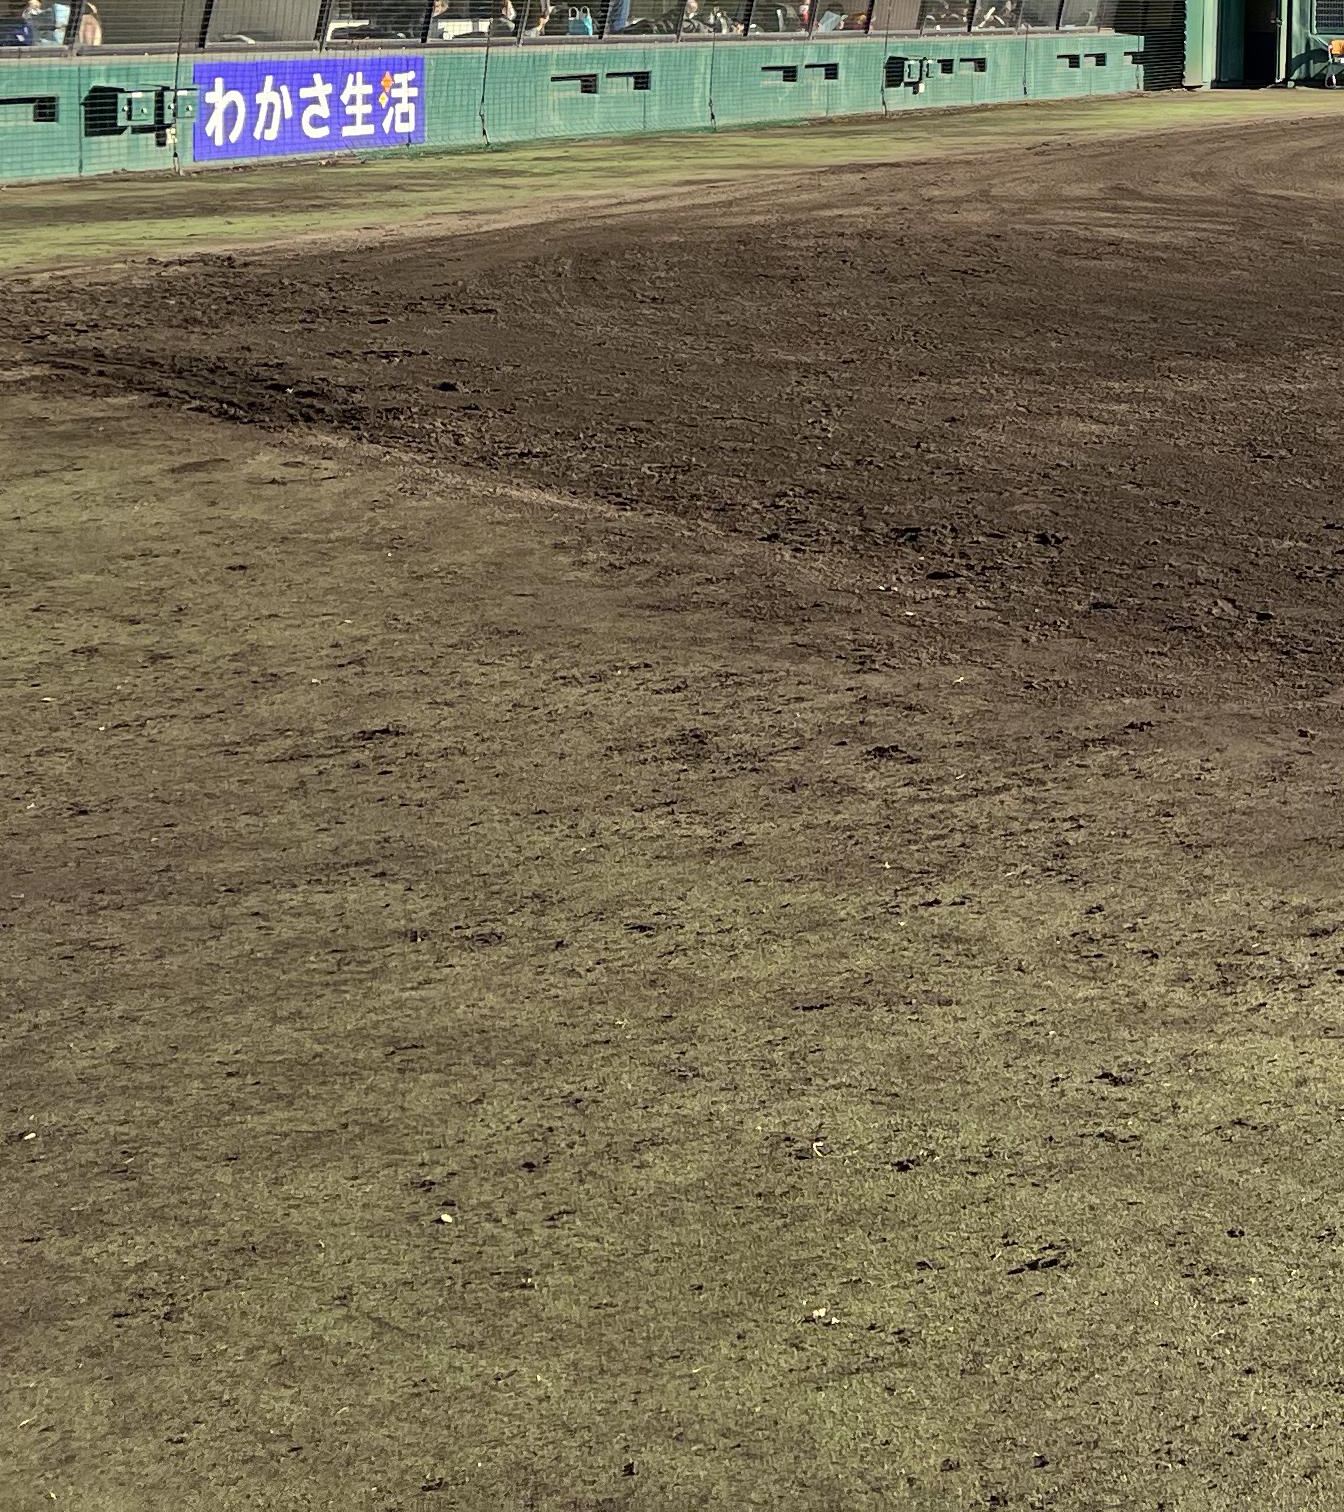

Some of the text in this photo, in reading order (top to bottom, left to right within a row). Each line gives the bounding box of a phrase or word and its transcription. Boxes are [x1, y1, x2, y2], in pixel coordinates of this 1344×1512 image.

[205, 71, 419, 147] わかさ生活
